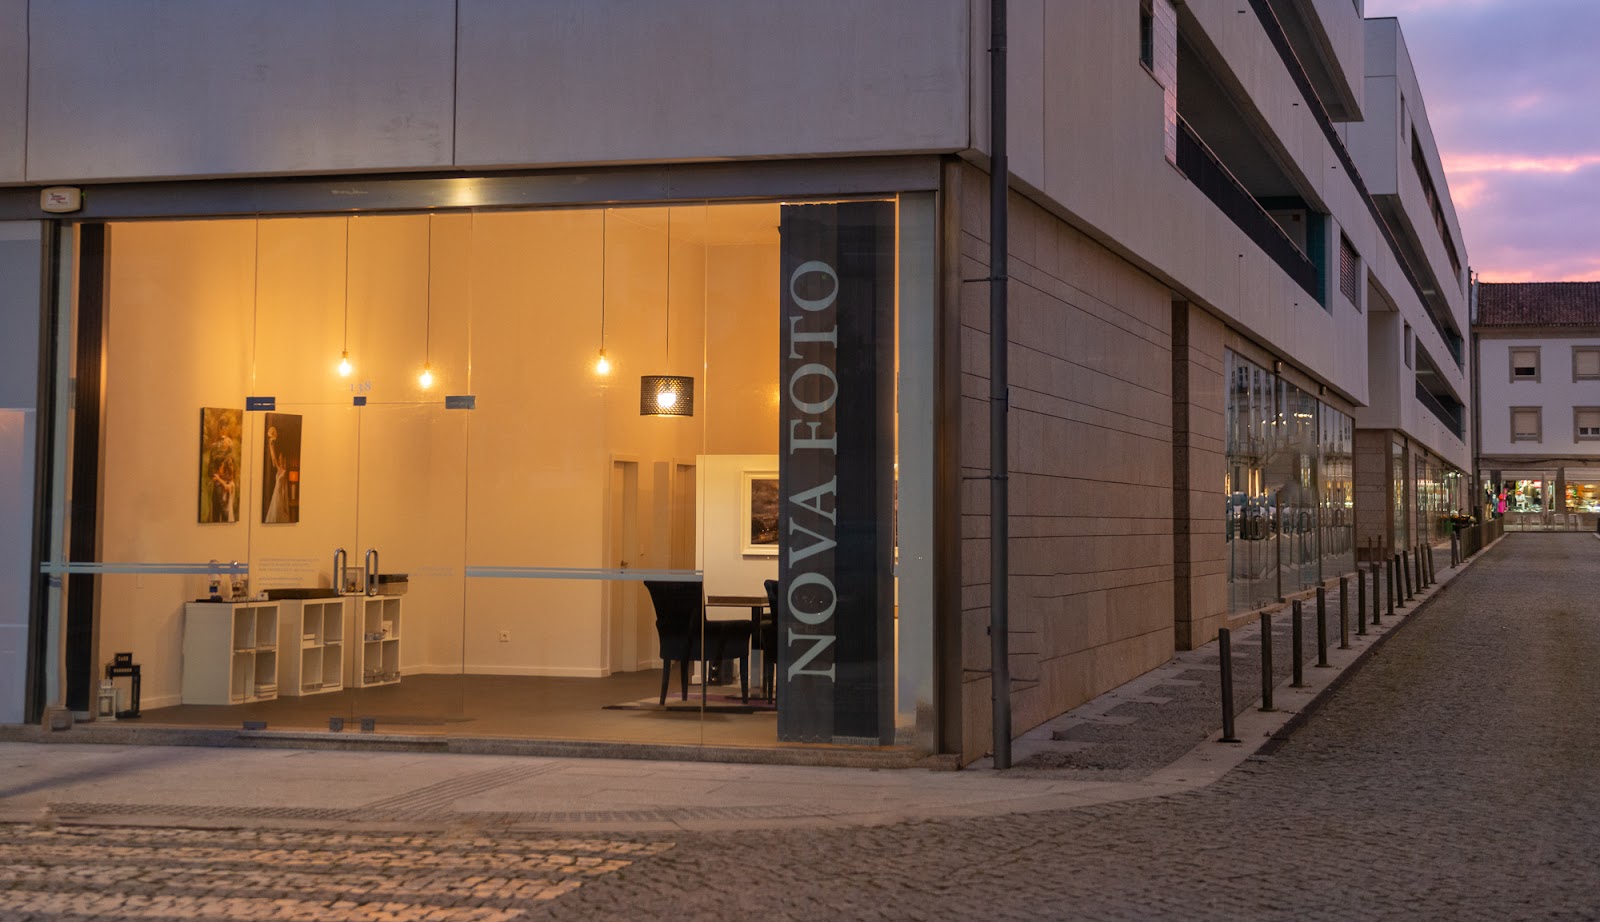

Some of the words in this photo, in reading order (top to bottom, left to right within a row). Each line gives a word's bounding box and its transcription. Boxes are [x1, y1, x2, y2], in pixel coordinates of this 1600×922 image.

[350, 379, 371, 394] 138
[789, 260, 839, 455] FOTO
[787, 475, 838, 683] NOVA
